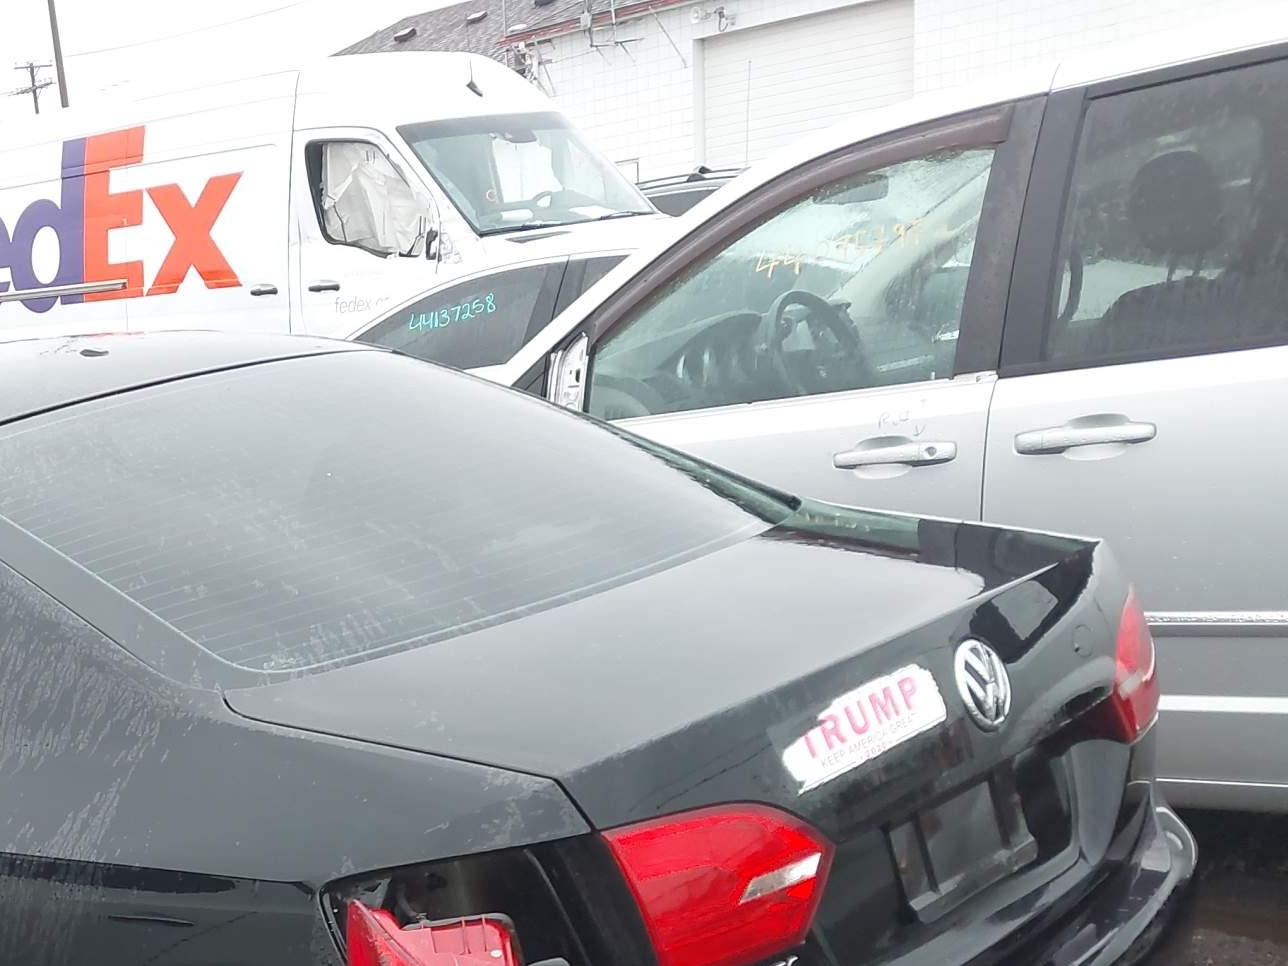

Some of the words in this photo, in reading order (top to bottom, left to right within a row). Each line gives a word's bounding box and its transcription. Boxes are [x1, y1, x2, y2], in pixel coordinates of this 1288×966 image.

[408, 292, 497, 331] 44137258
[803, 676, 918, 759] TRUMP
[820, 749, 848, 769] KEEP
[847, 729, 889, 754] AMERCA
